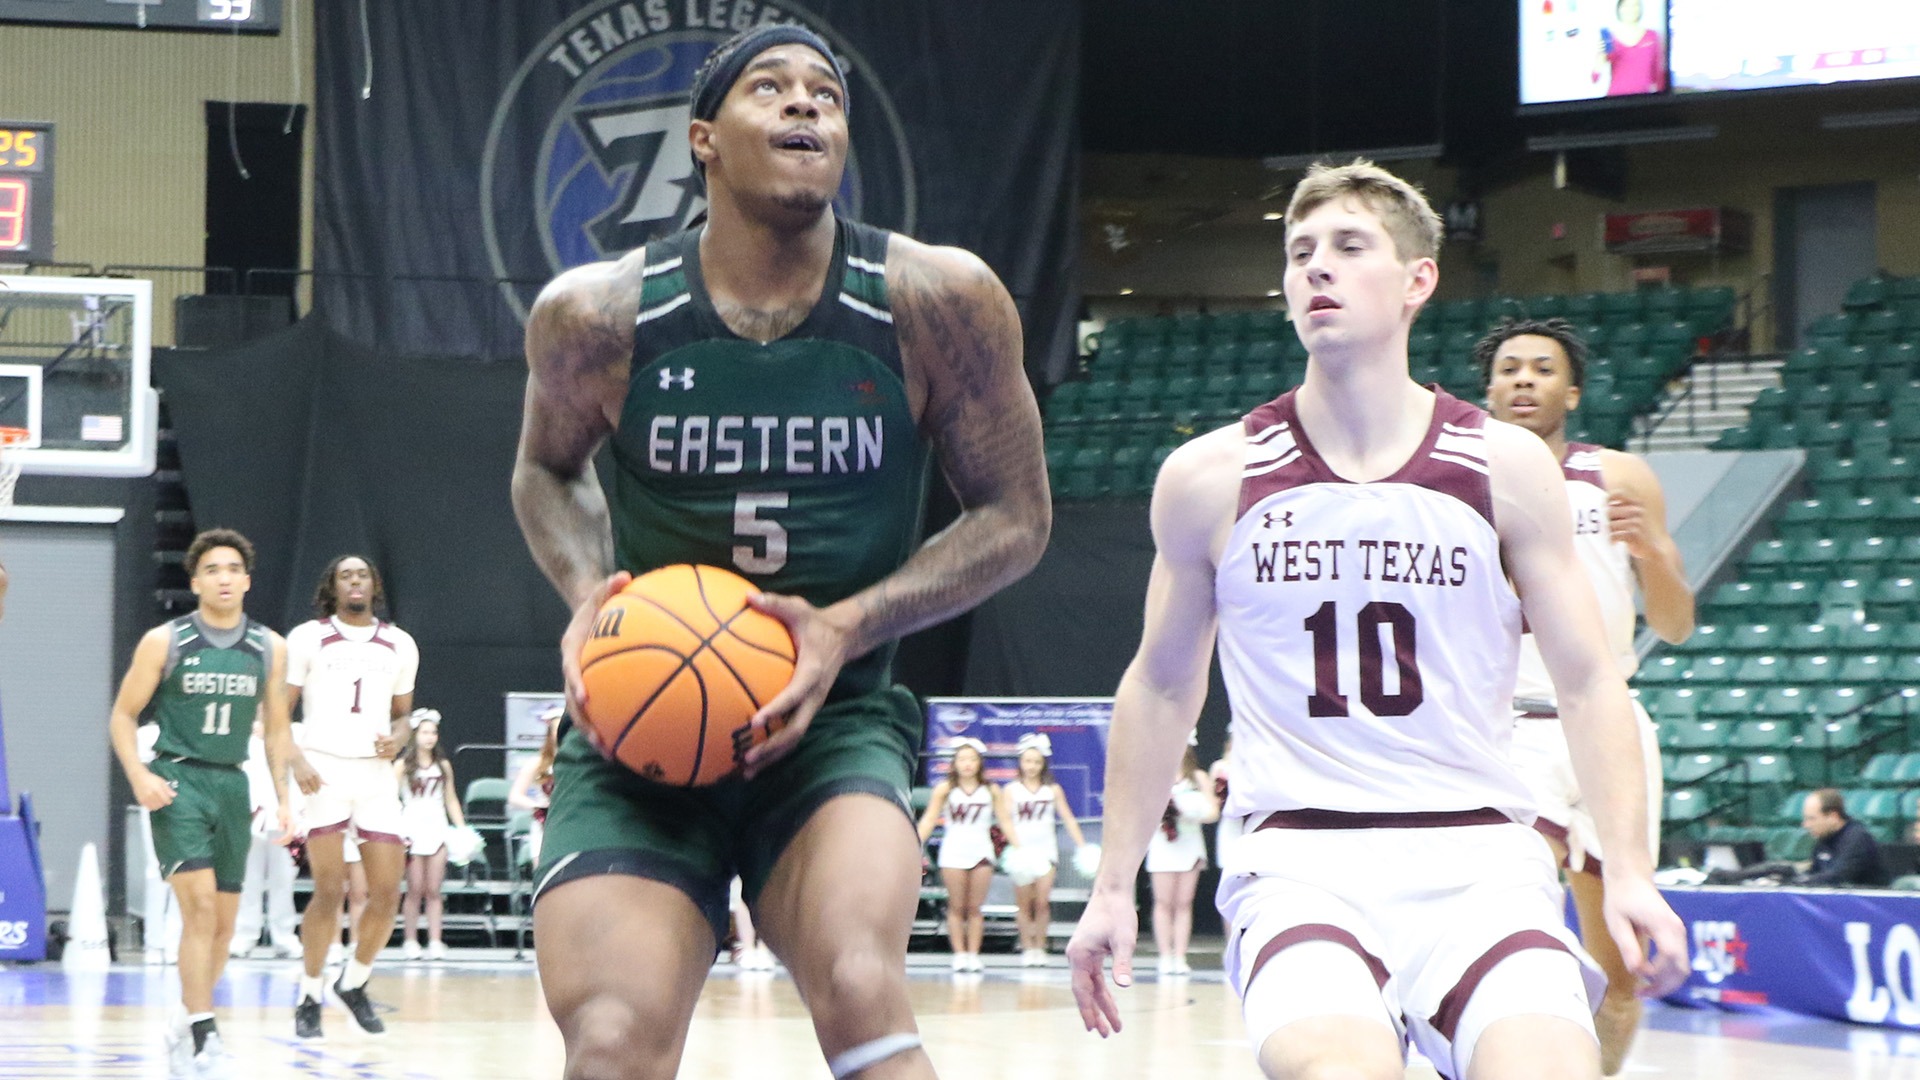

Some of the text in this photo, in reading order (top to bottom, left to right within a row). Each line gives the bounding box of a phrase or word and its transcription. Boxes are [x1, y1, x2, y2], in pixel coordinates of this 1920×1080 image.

[548, 0, 672, 79] TEXAS
[649, 415, 884, 474] EASTERN
[732, 491, 789, 575] 5
[1252, 539, 1468, 587] WEST TEXAS
[1303, 600, 1424, 718] 10
[182, 672, 258, 698] EASTERN
[350, 677, 363, 714] 1
[201, 701, 232, 736] 11
[949, 802, 988, 825] WT
[1016, 799, 1051, 822] WT
